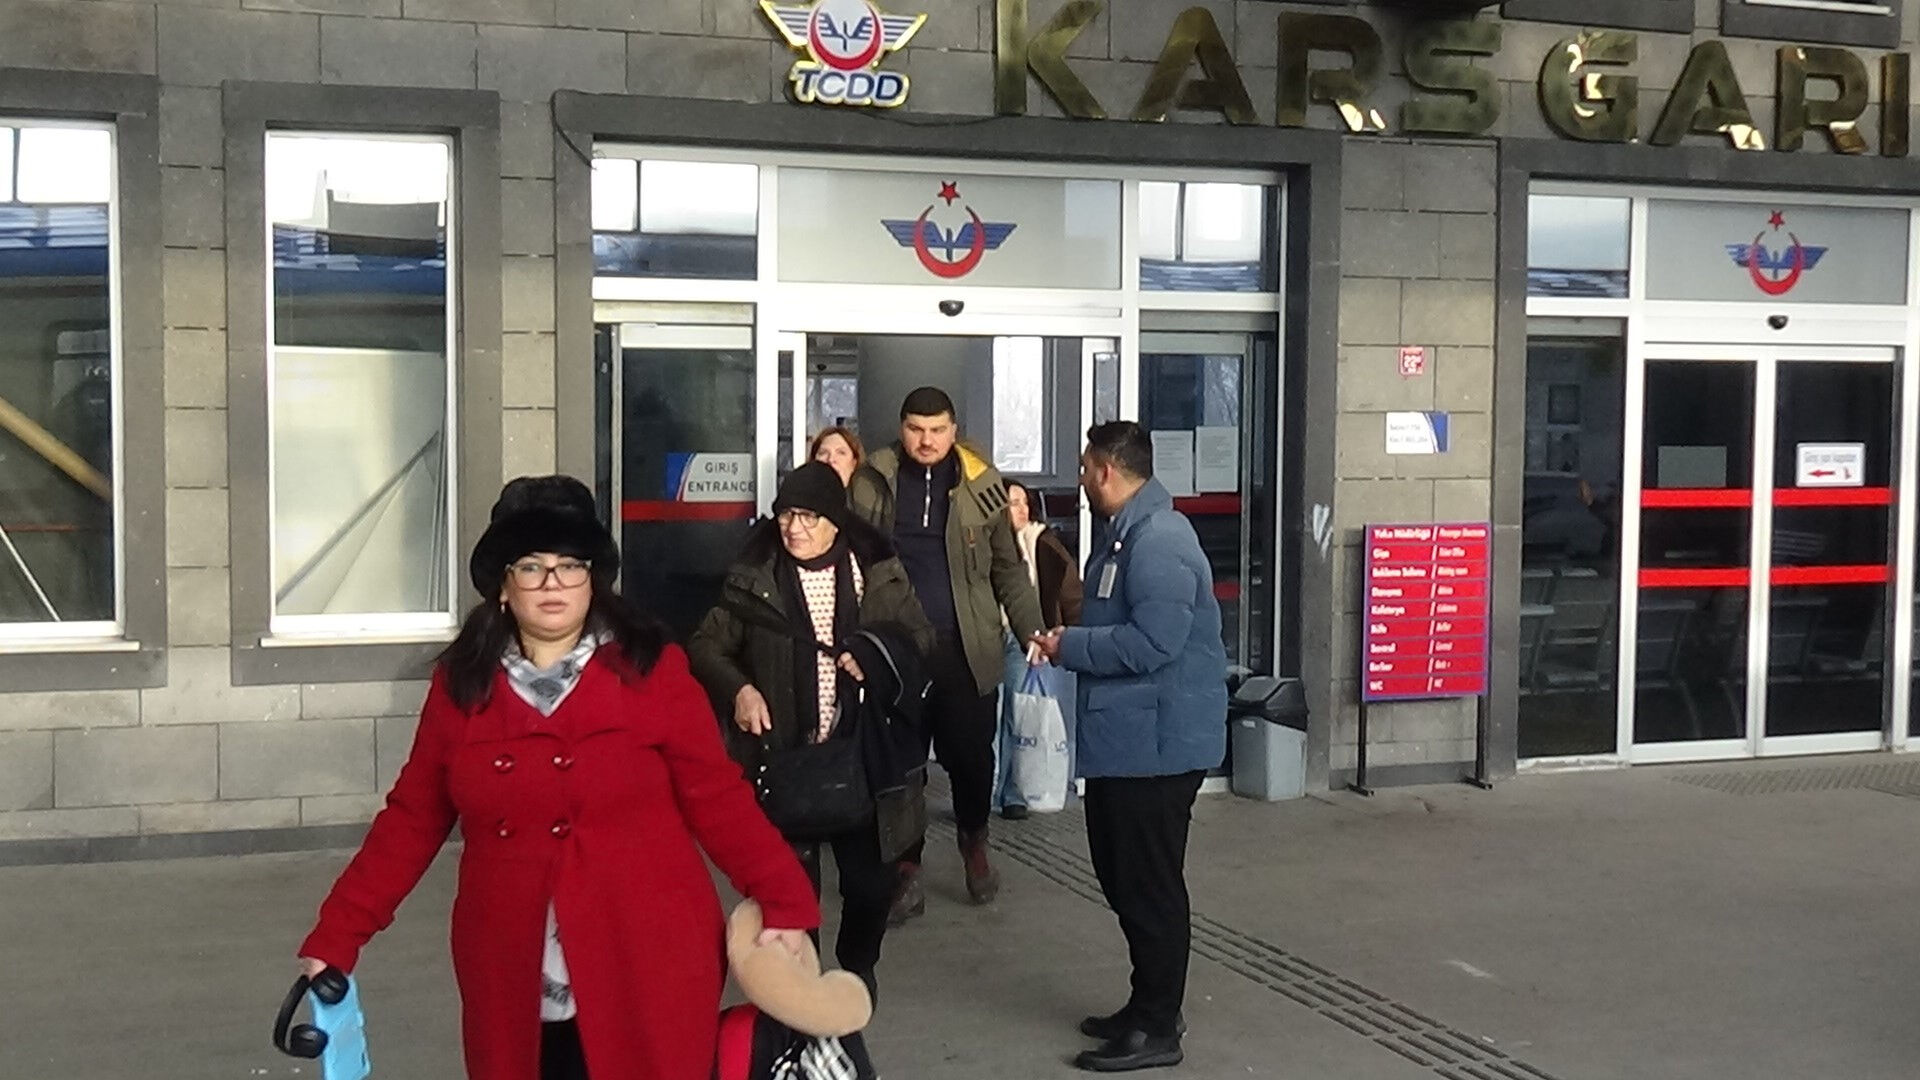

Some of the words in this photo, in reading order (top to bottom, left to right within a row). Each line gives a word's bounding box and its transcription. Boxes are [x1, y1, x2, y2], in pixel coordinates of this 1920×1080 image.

[794, 64, 906, 104] TCDD
[993, 0, 1503, 137] KARS
[1536, 28, 1911, 157] GARI
[687, 480, 756, 494] ENTRANCE
